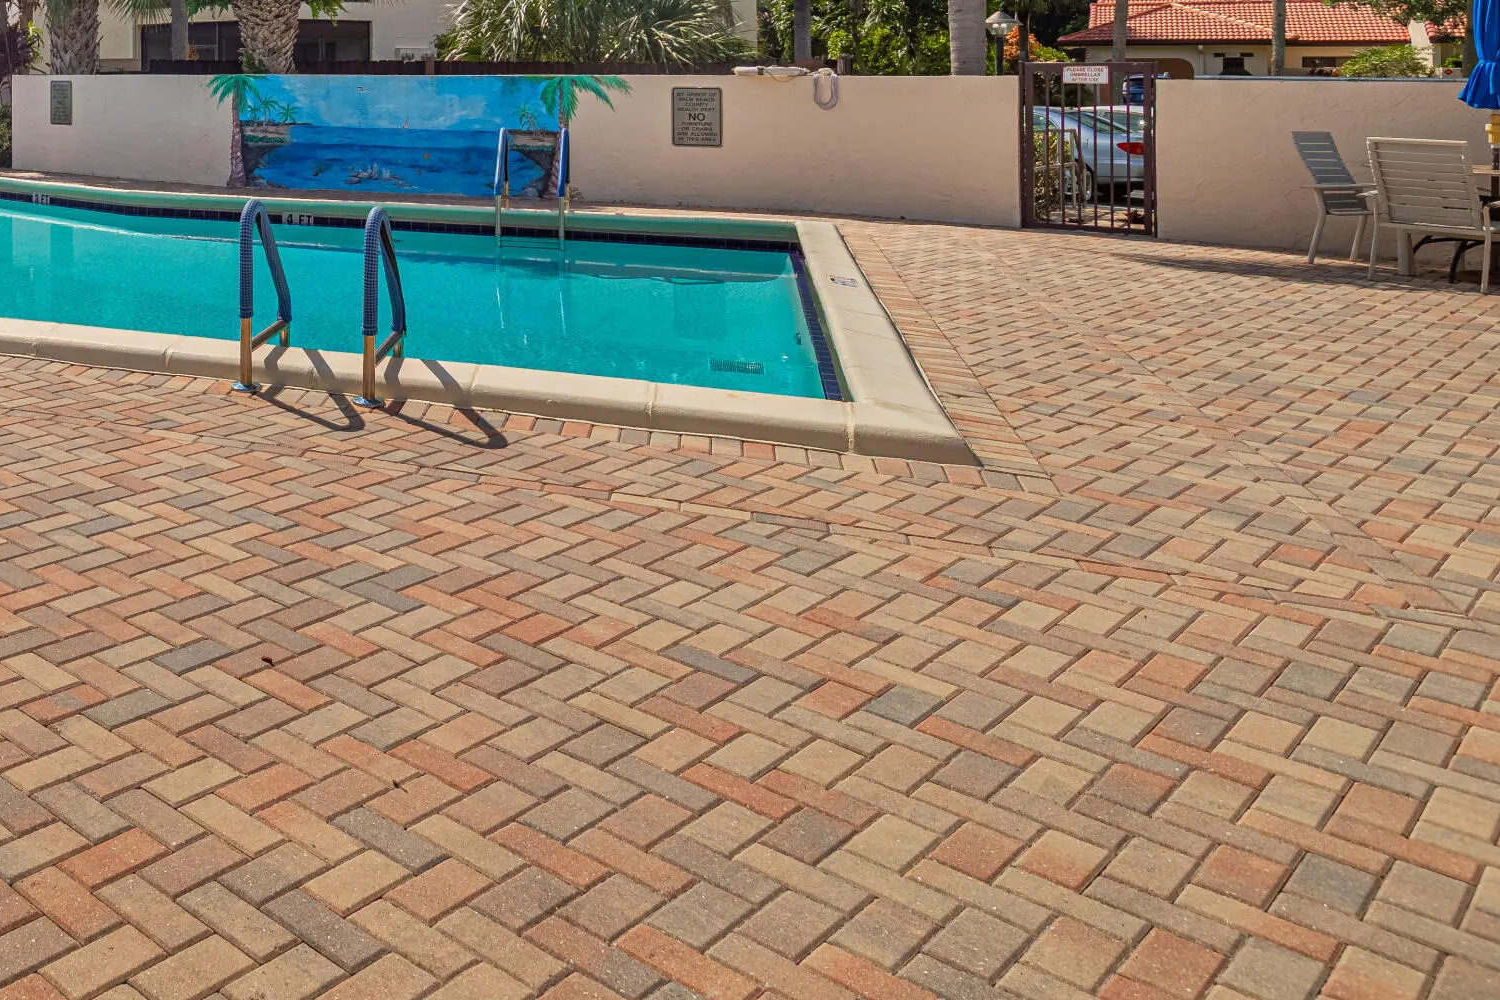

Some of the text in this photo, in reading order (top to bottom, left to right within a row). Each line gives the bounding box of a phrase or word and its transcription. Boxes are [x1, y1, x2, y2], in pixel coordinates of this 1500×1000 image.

[688, 112, 706, 121] NO
[286, 213, 313, 225] 4 FT
